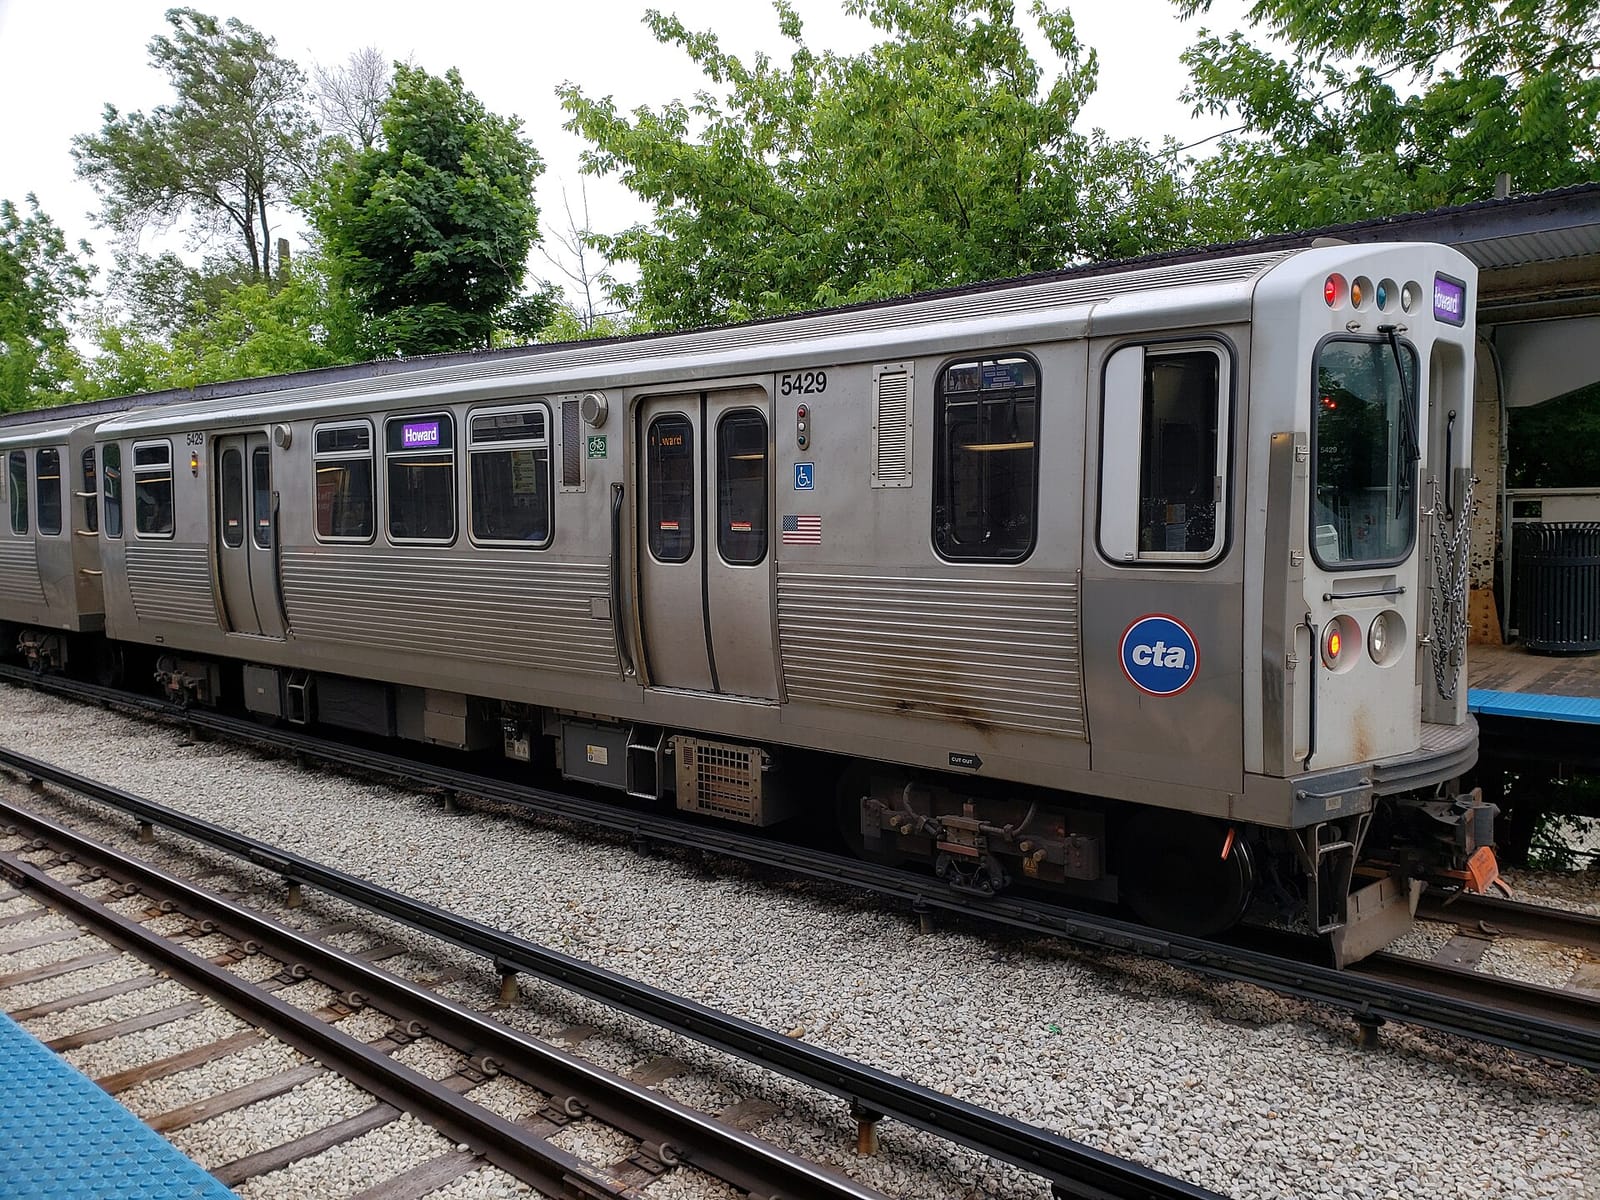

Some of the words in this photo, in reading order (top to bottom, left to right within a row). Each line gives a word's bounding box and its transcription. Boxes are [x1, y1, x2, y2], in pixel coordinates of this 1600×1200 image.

[781, 371, 827, 396] 5429
[186, 432, 204, 446] 5429
[405, 426, 437, 442] Howard
[1132, 641, 1187, 669] cta
